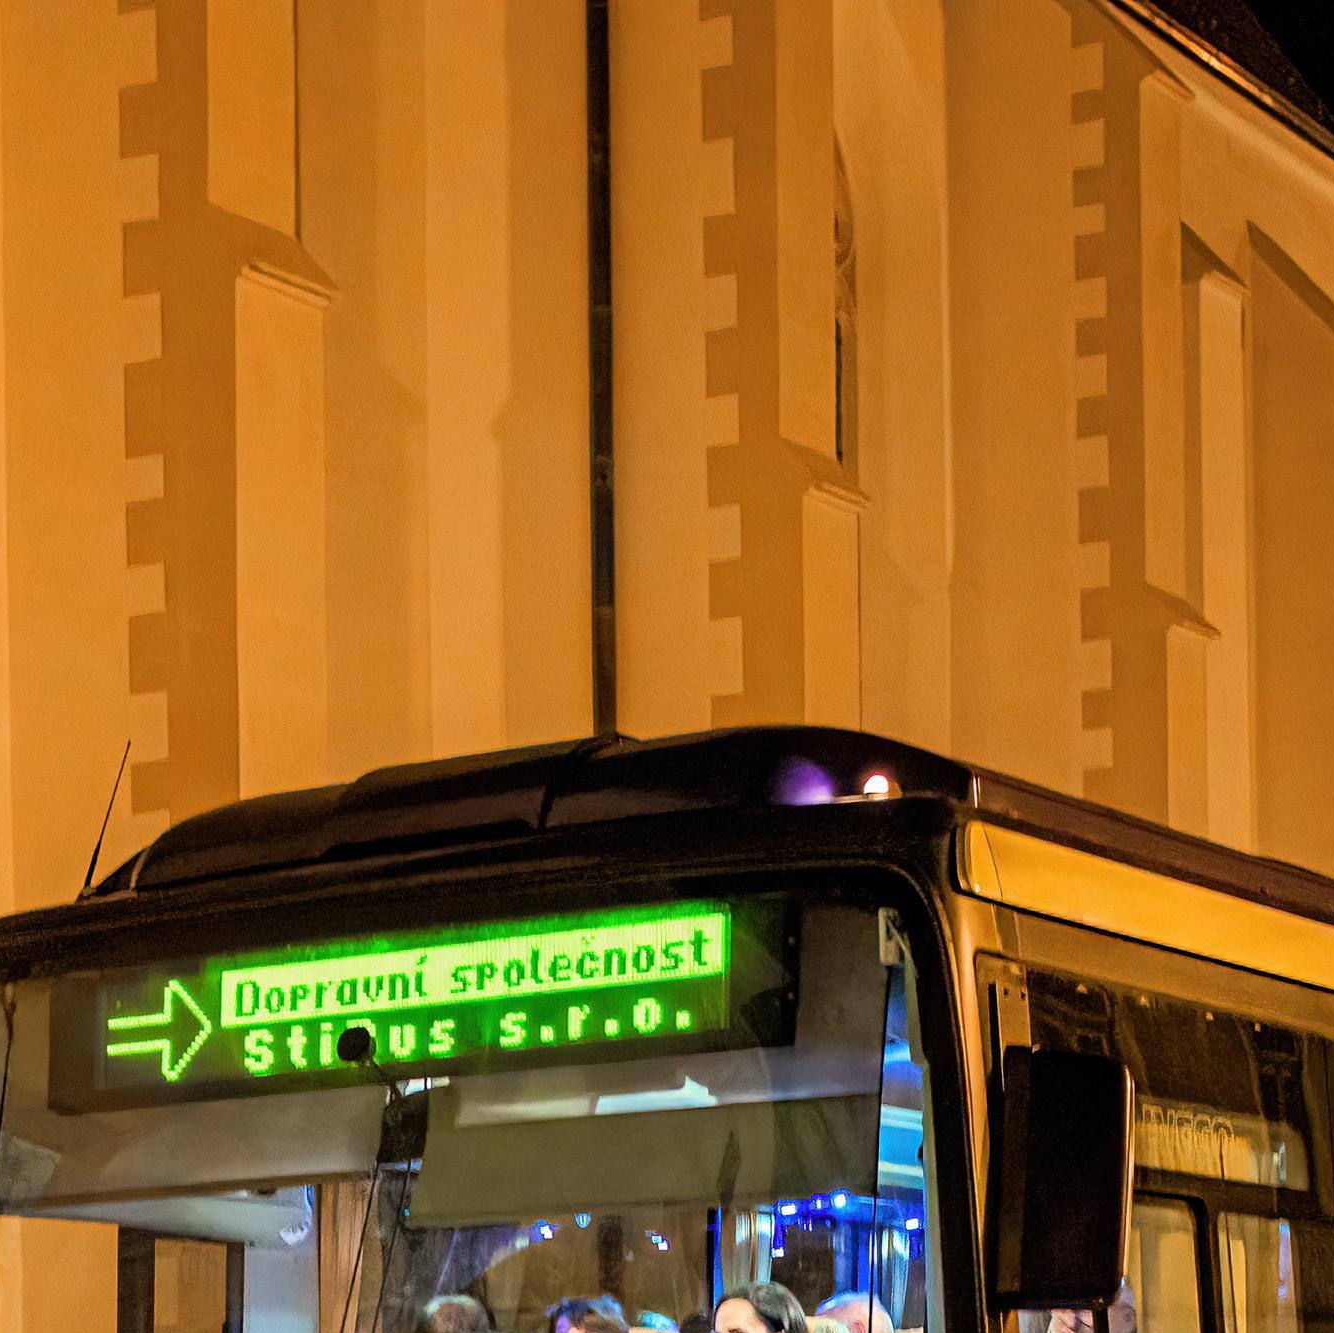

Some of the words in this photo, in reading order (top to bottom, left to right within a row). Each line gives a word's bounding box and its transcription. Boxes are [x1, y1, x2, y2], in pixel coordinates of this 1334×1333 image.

[235, 954, 427, 1018] Dopravní
[450, 929, 709, 994] společnost
[499, 997, 693, 1049] s.r.o.
